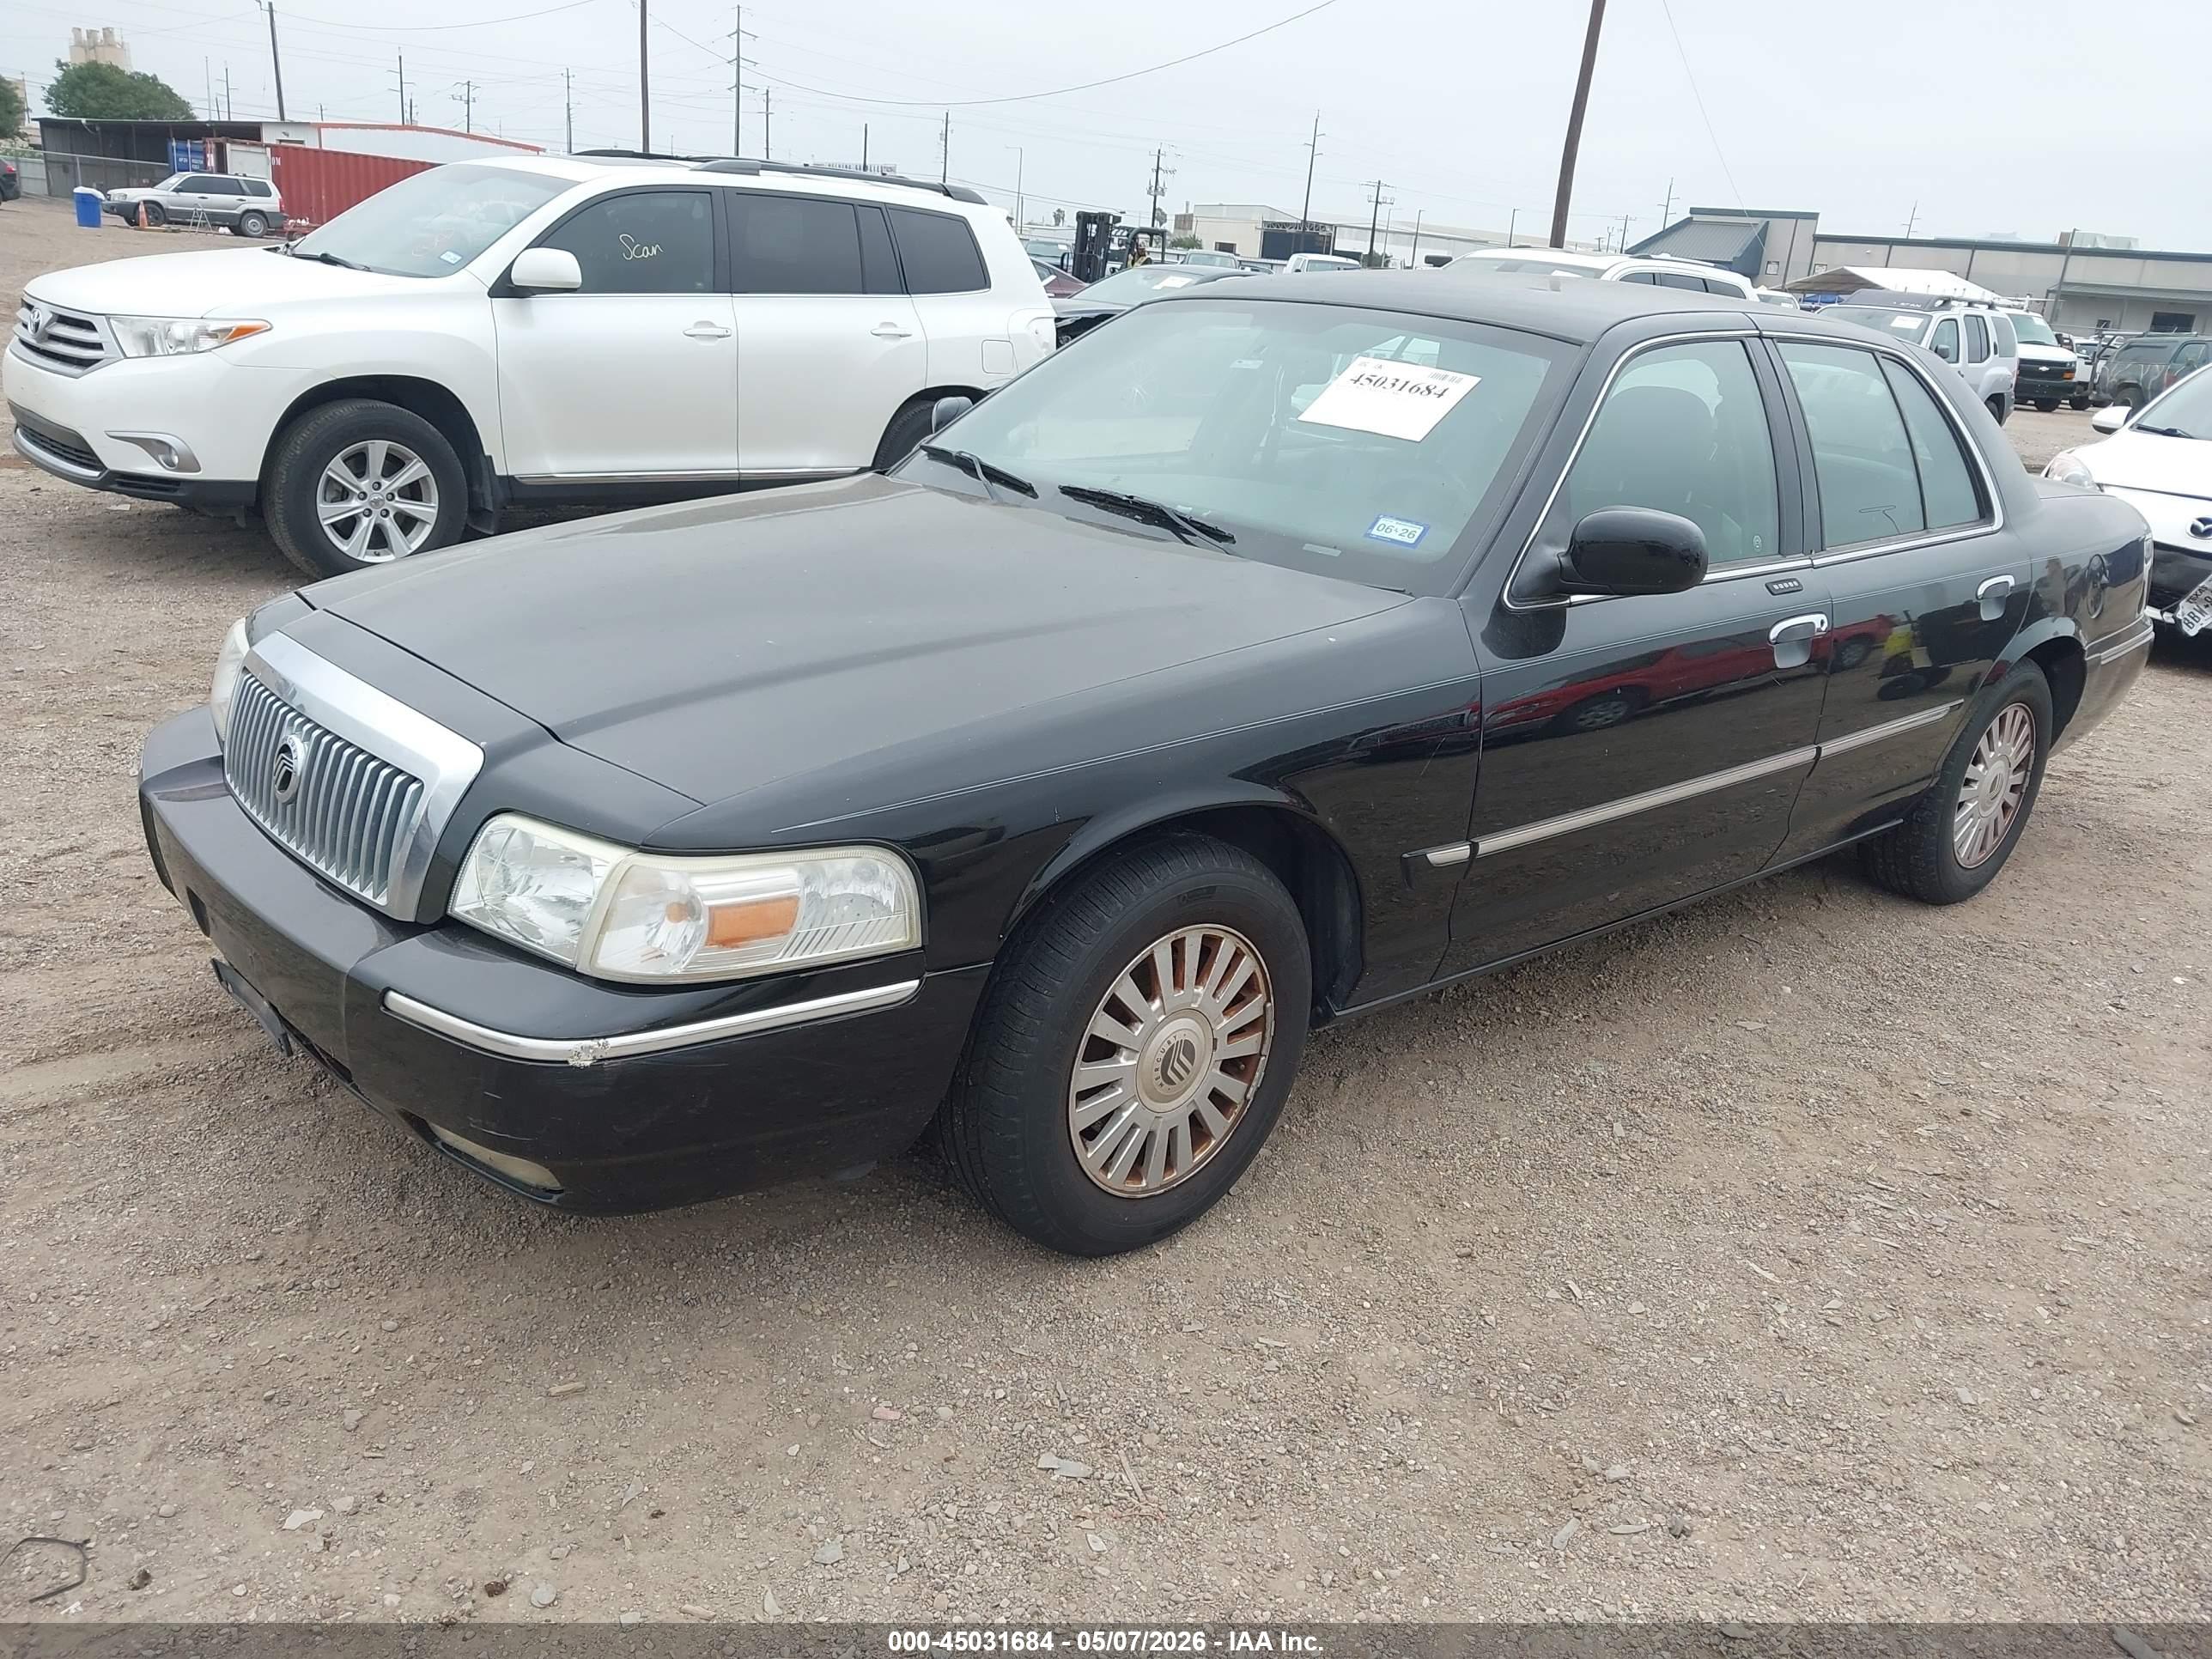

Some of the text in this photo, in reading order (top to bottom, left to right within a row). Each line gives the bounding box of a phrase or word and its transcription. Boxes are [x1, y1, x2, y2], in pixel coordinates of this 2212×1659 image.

[619, 234, 664, 260] Scan
[1349, 373, 1449, 398] 45031684
[2185, 584, 2208, 605] TEXAS
[1153, 1035, 1177, 1088] MERCURY
